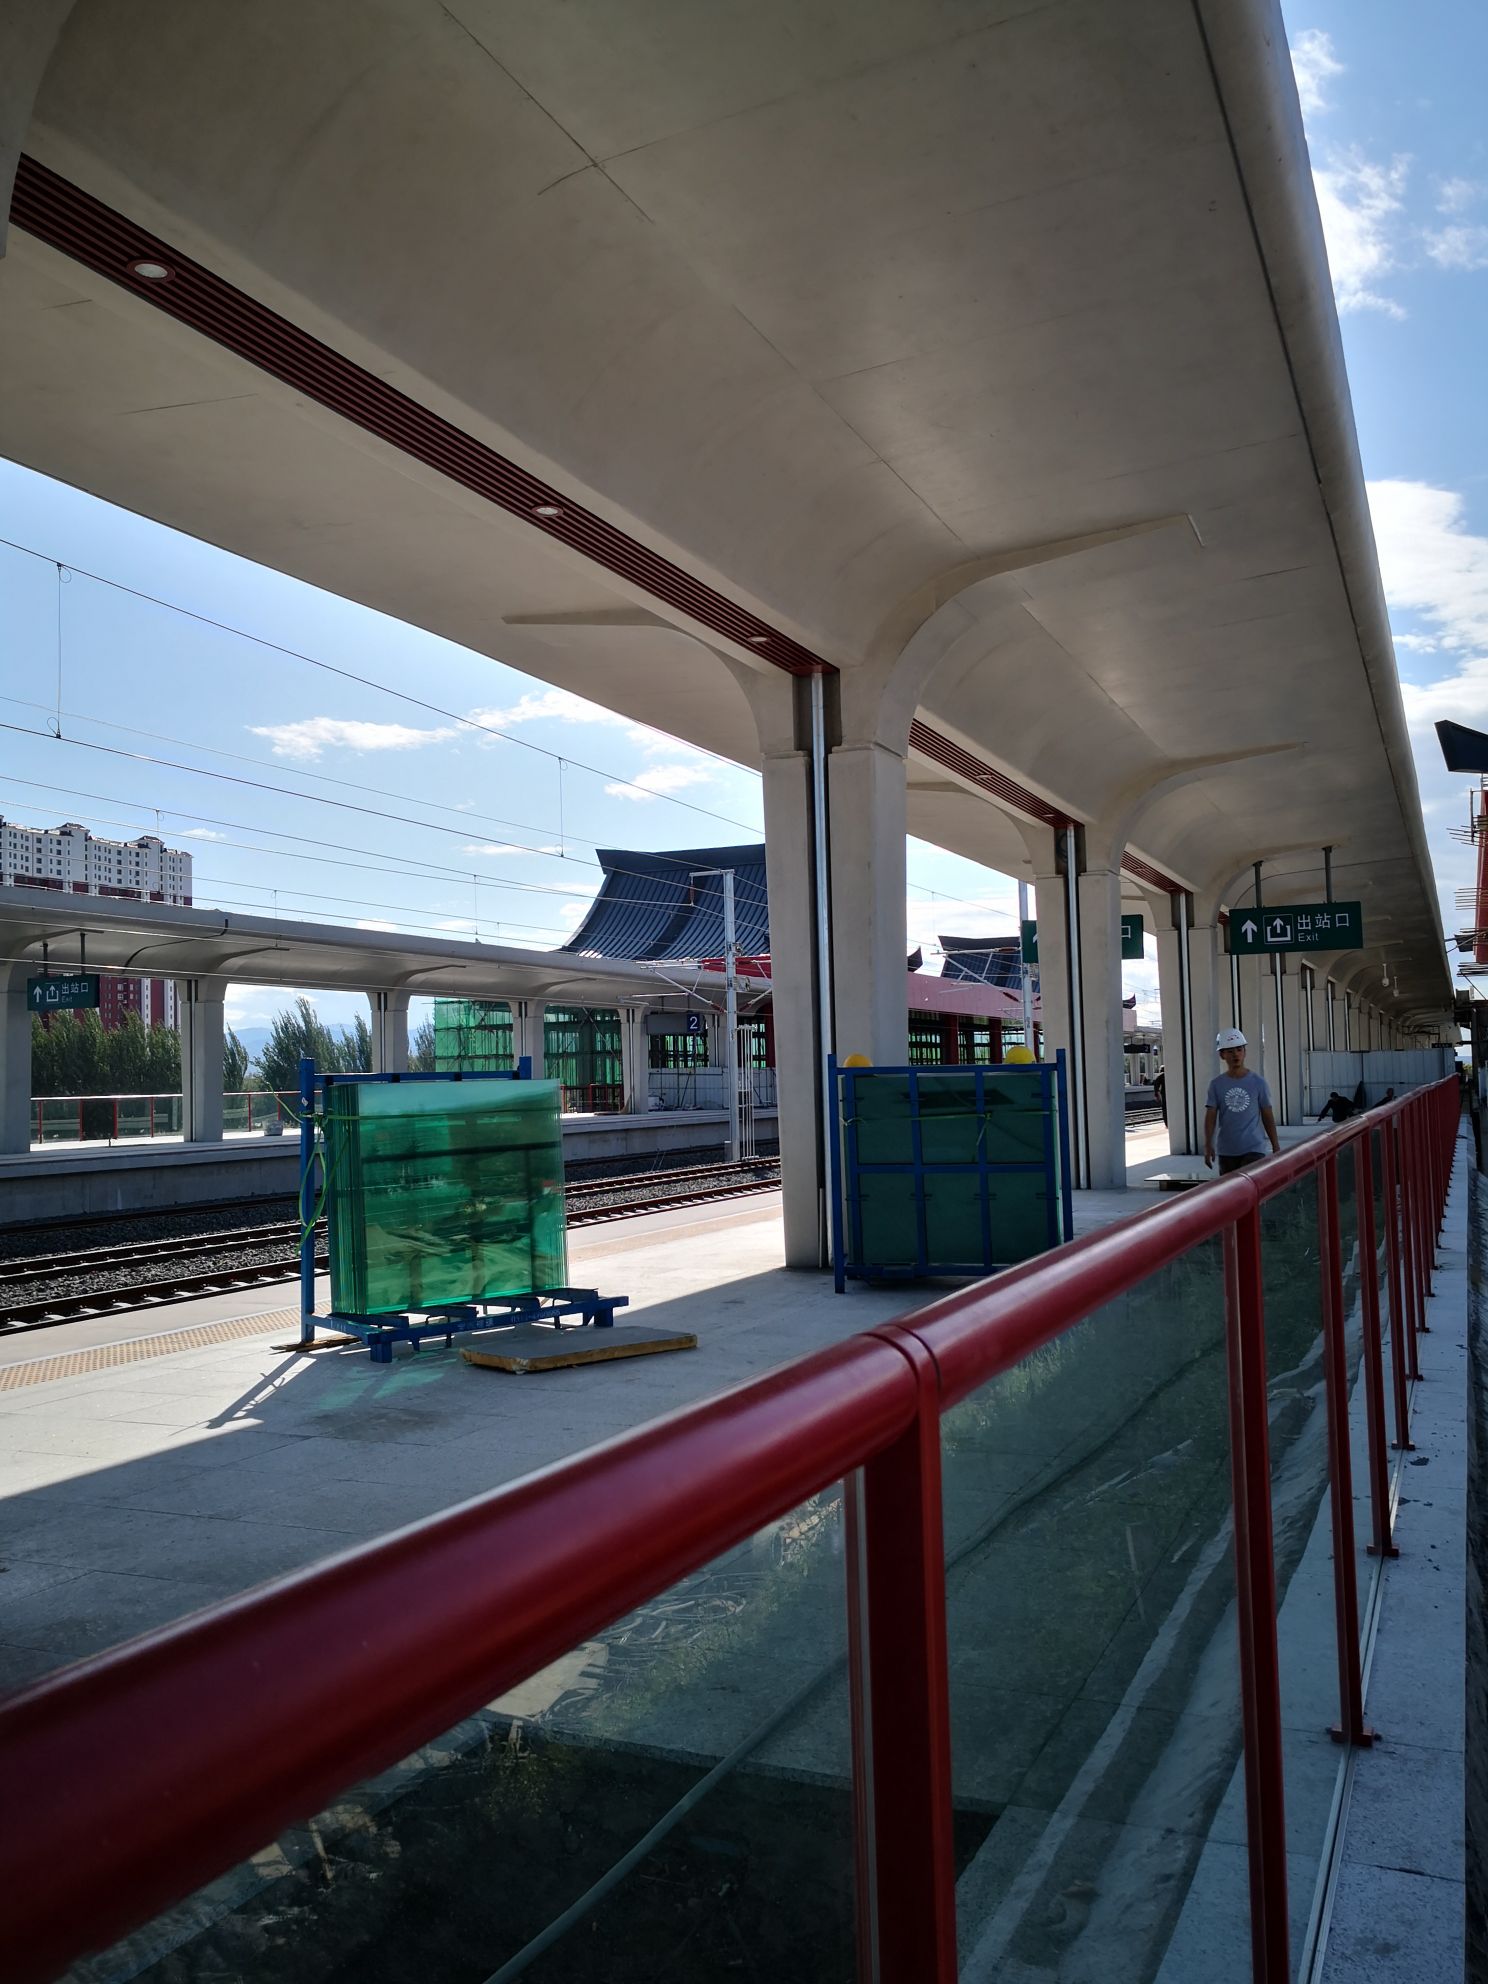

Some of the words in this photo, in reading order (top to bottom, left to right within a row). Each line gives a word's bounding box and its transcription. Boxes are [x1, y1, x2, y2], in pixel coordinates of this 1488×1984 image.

[1297, 912, 1350, 930] 出站口
[1298, 932, 1320, 942] Exit
[61, 982, 88, 994] 出站口
[689, 1016, 698, 1029] 2
